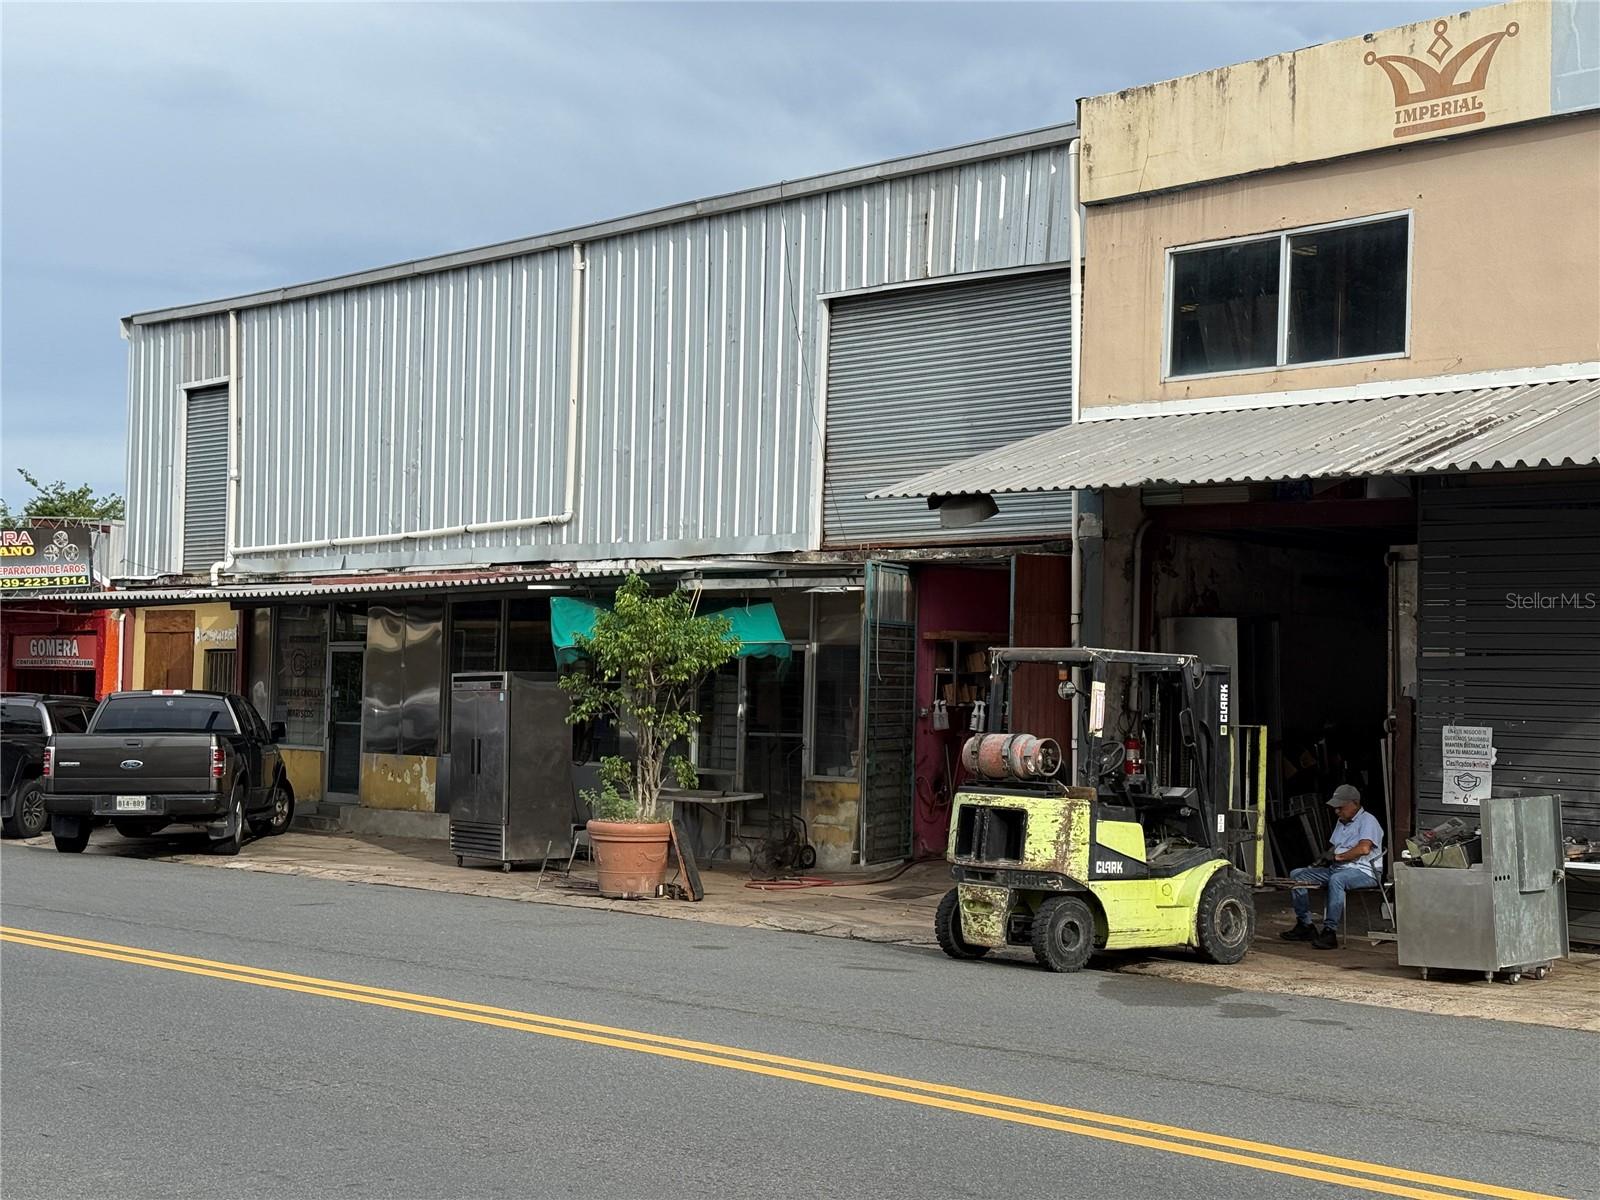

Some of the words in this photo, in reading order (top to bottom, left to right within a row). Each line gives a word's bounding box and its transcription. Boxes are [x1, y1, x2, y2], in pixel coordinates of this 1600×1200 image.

[1395, 95, 1483, 125] IMPERIAL
[0, 530, 34, 546] RA
[49, 565, 61, 574] DE
[63, 564, 87, 574] AROS
[0, 576, 87, 588] 39-223-1914
[30, 639, 80, 657] GOMERA
[1220, 684, 1228, 723] CLARK
[1095, 860, 1123, 874] CLARK
